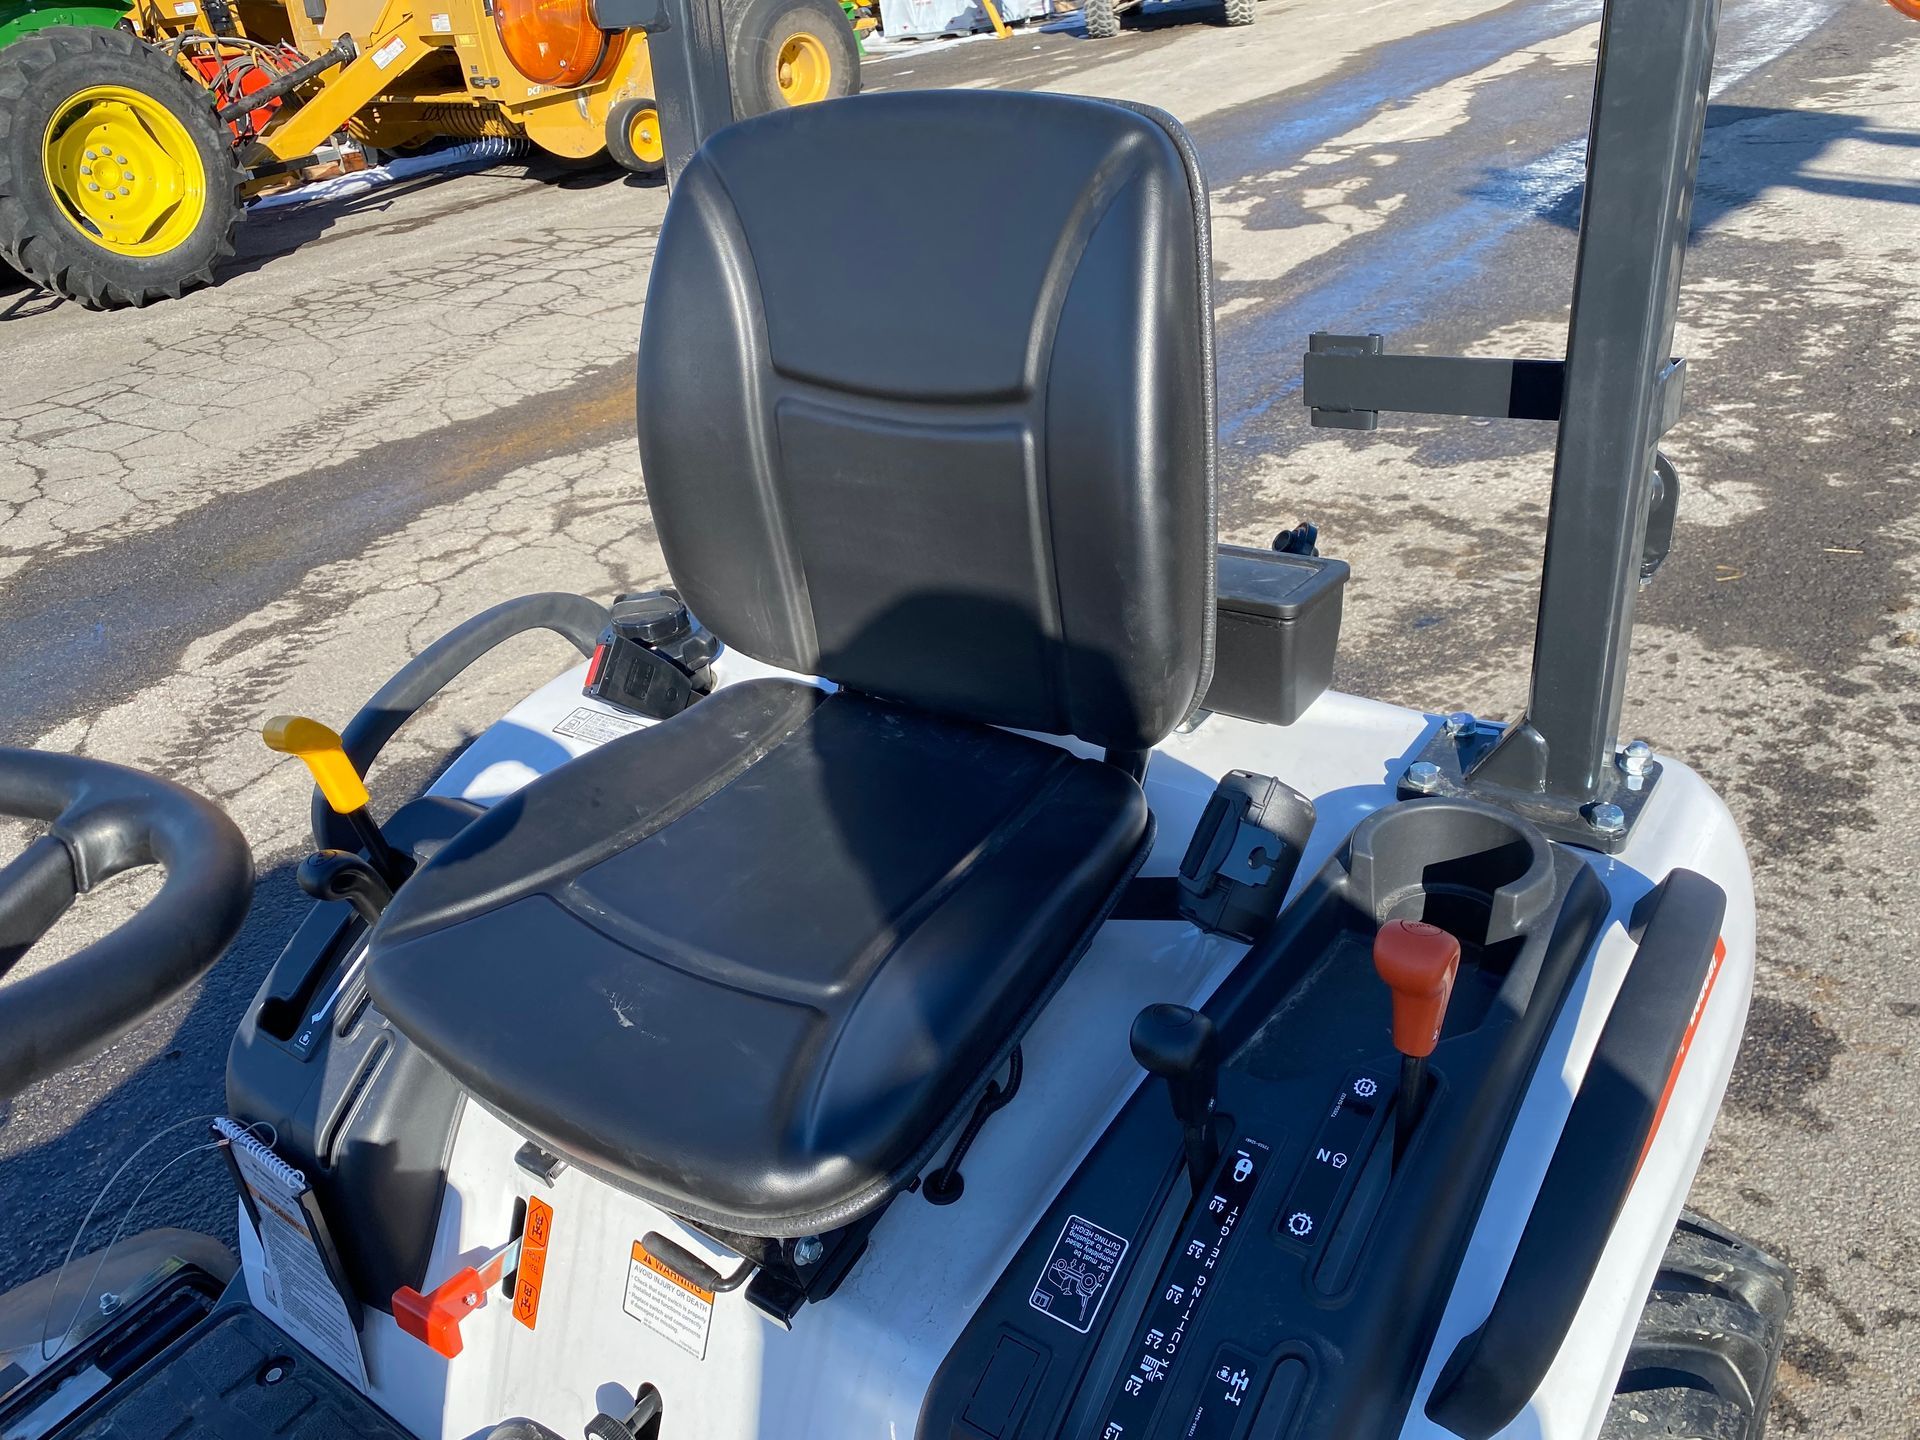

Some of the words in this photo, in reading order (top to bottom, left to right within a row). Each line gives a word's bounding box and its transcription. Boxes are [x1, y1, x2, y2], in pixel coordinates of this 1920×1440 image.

[1316, 1148, 1332, 1163] N
[1208, 1199, 1225, 1214] 4.0
[1064, 1237, 1083, 1250] raised
[1069, 1230, 1096, 1248] adjusting
[1094, 1233, 1121, 1251] CUTTING
[1073, 1250, 1082, 1258] be
[1082, 1253, 1099, 1265] must
[1084, 1246, 1115, 1265] completely
[1102, 1247, 1119, 1258] prior
[1186, 1244, 1204, 1260] 3.5
[1098, 1262, 1112, 1273] 3PT
[655, 1259, 702, 1295] WARNING
[1166, 1275, 1207, 1354] CUTTING
[1204, 1206, 1239, 1270] HEIGHT
[634, 1264, 653, 1281] AVOID
[654, 1276, 675, 1294] INJURY
[675, 1289, 686, 1301] OR
[686, 1295, 708, 1313] DEATH
[1165, 1288, 1183, 1305] 3.0
[634, 1275, 649, 1288] Check
[648, 1282, 657, 1293] that
[667, 1294, 683, 1308] switch
[687, 1308, 707, 1325] properly
[651, 1294, 661, 1304] and
[660, 1298, 682, 1316] functions
[631, 1291, 650, 1306] Replace
[649, 1300, 664, 1314] switch
[663, 1311, 673, 1321] and
[673, 1315, 702, 1339] components
[634, 1301, 655, 1319] damaged
[1144, 1333, 1163, 1350] 2.5
[1124, 1379, 1142, 1397] 2.0
